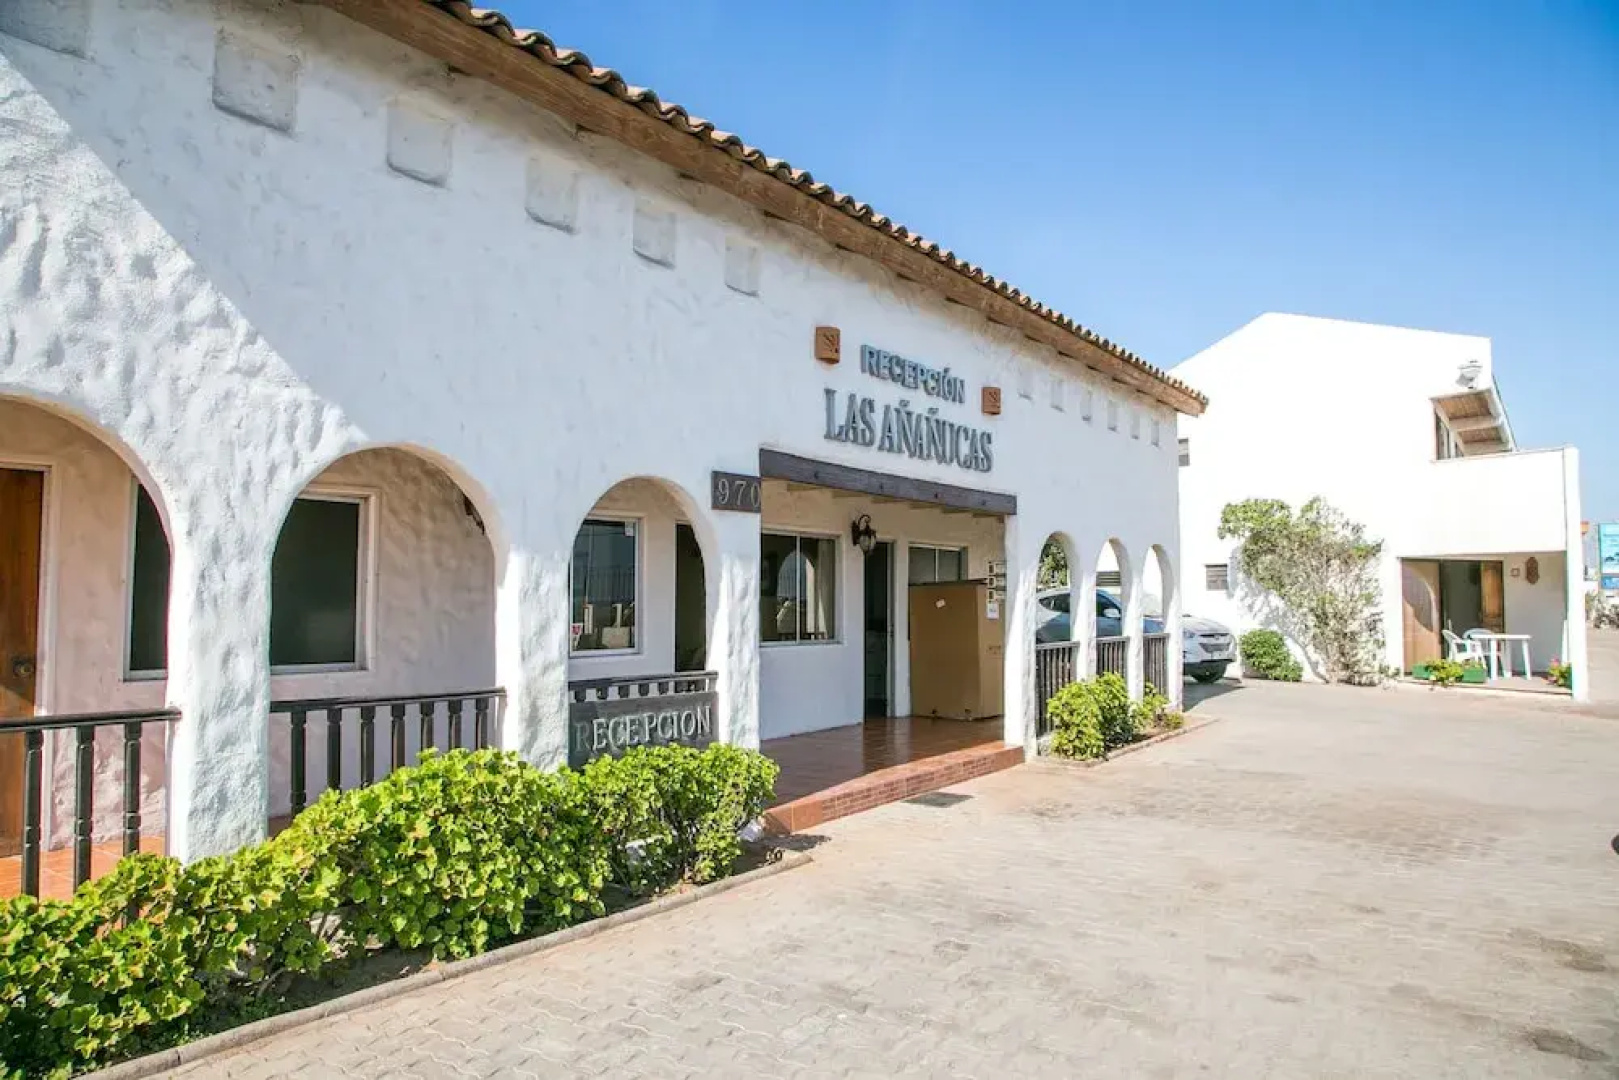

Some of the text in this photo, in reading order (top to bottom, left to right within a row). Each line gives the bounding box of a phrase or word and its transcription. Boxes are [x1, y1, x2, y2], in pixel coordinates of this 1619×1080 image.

[860, 344, 966, 404] RECEPCIÓN
[824, 388, 876, 447] LAS
[718, 478, 760, 508] 970
[574, 704, 711, 753] RECEPCION
